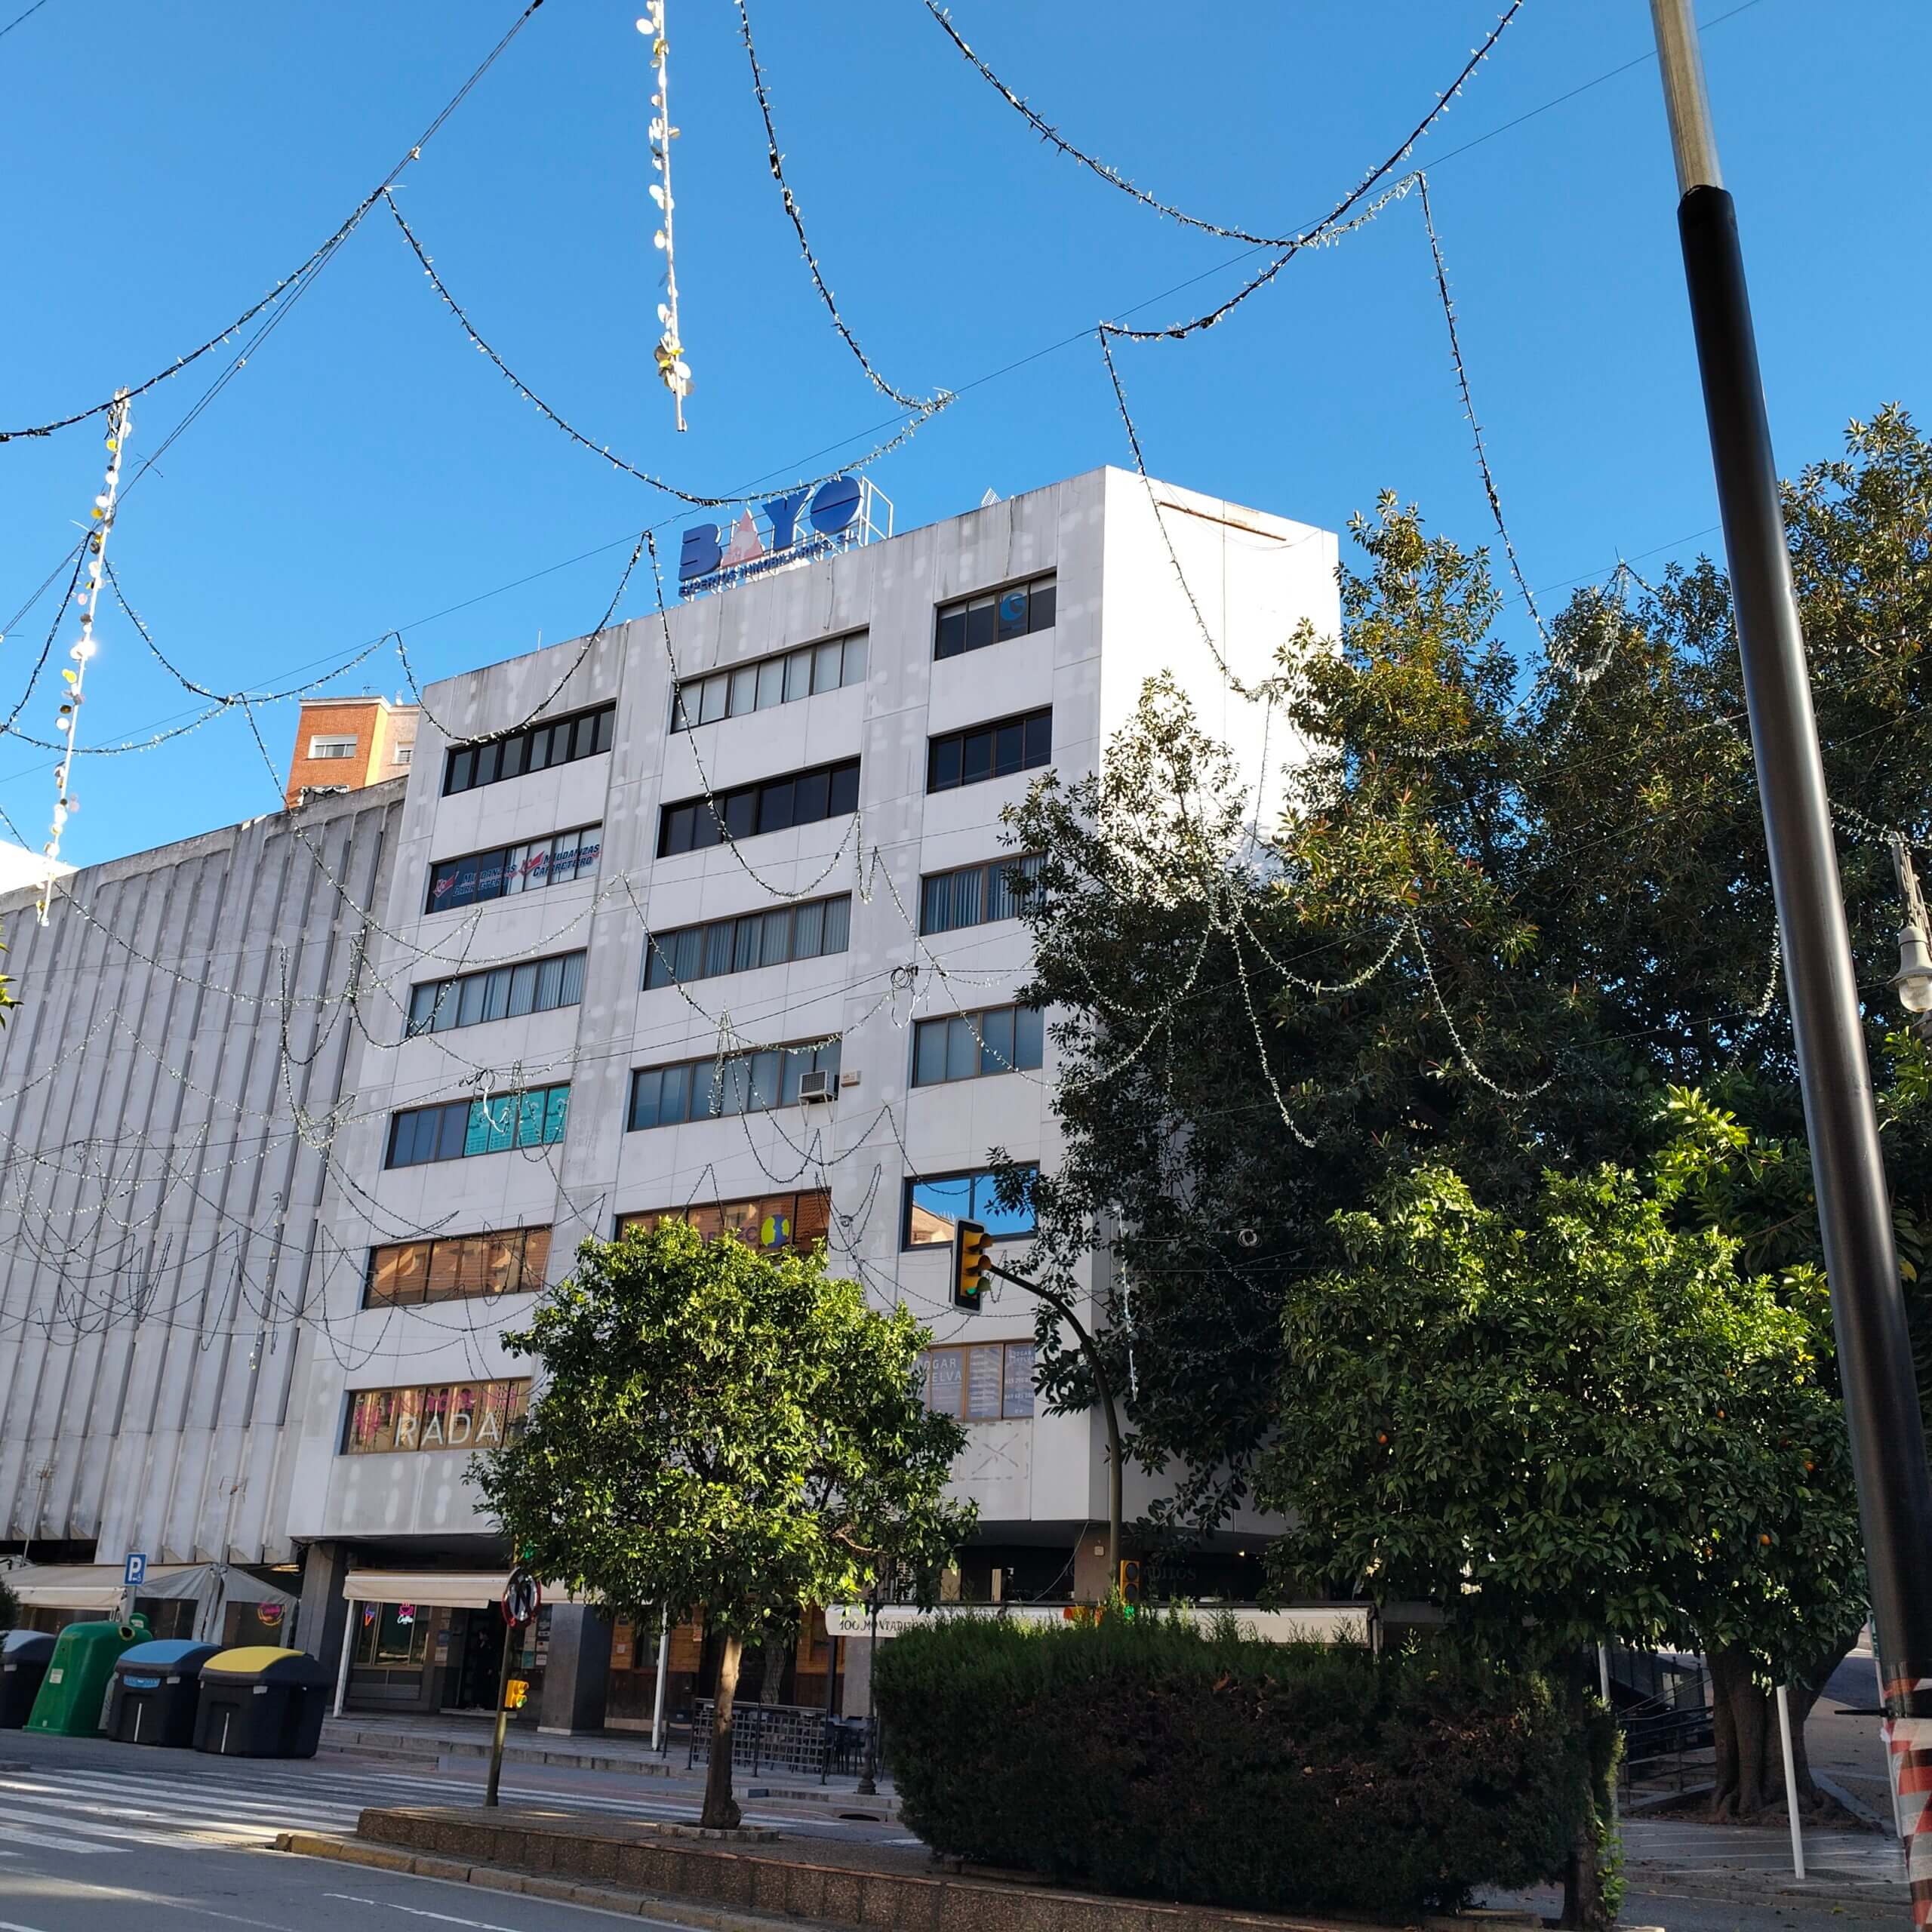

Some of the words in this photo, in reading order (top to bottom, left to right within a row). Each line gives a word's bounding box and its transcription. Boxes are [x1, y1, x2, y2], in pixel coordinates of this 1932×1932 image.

[678, 475, 863, 582] BAYO
[543, 844, 600, 865] MUDANZAS
[533, 857, 592, 877] CARRETERO
[395, 1412, 500, 1447] RADA
[128, 1557, 142, 1581] P
[839, 1619, 860, 1631] 100
